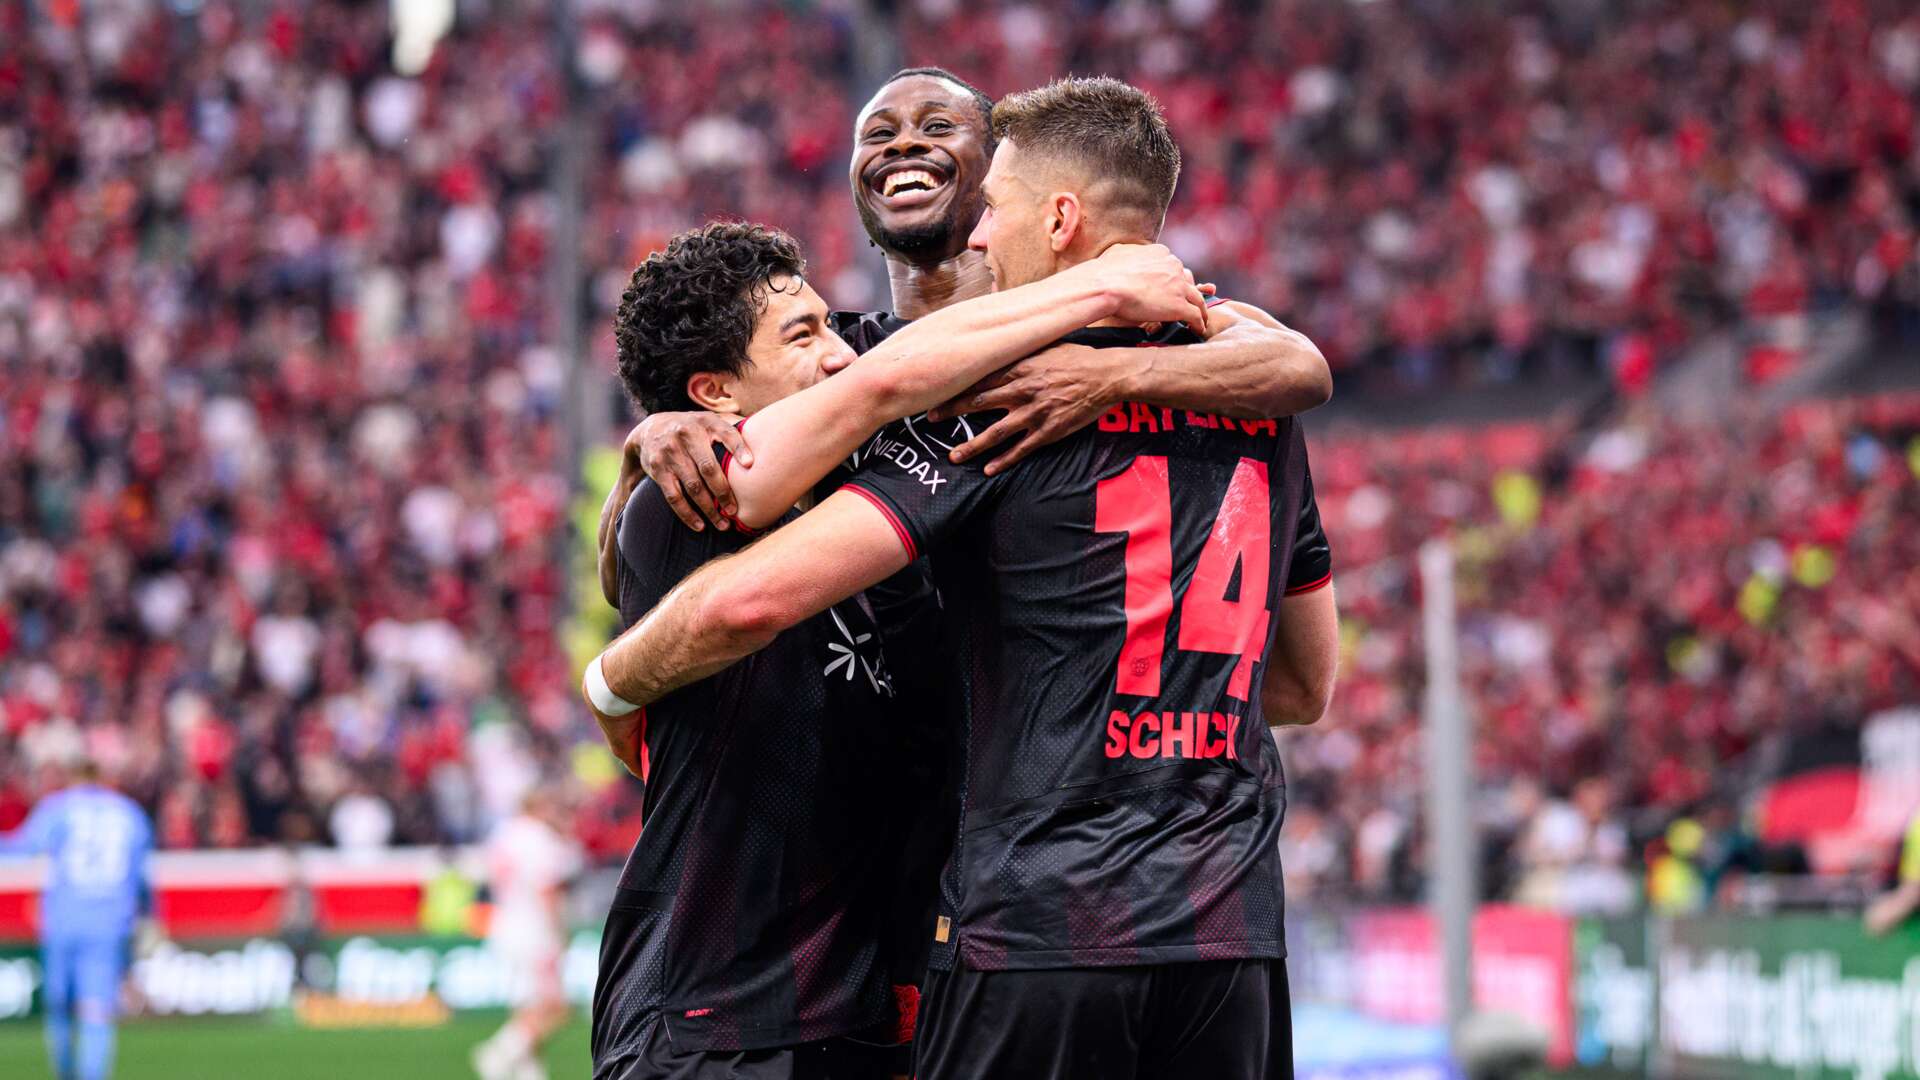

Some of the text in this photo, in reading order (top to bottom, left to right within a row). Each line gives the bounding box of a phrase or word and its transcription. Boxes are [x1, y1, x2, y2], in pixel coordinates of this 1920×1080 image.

[873, 437, 948, 495] NIEDAX
[1095, 455, 1271, 702] 14
[1104, 710, 1240, 761] SCHICK
